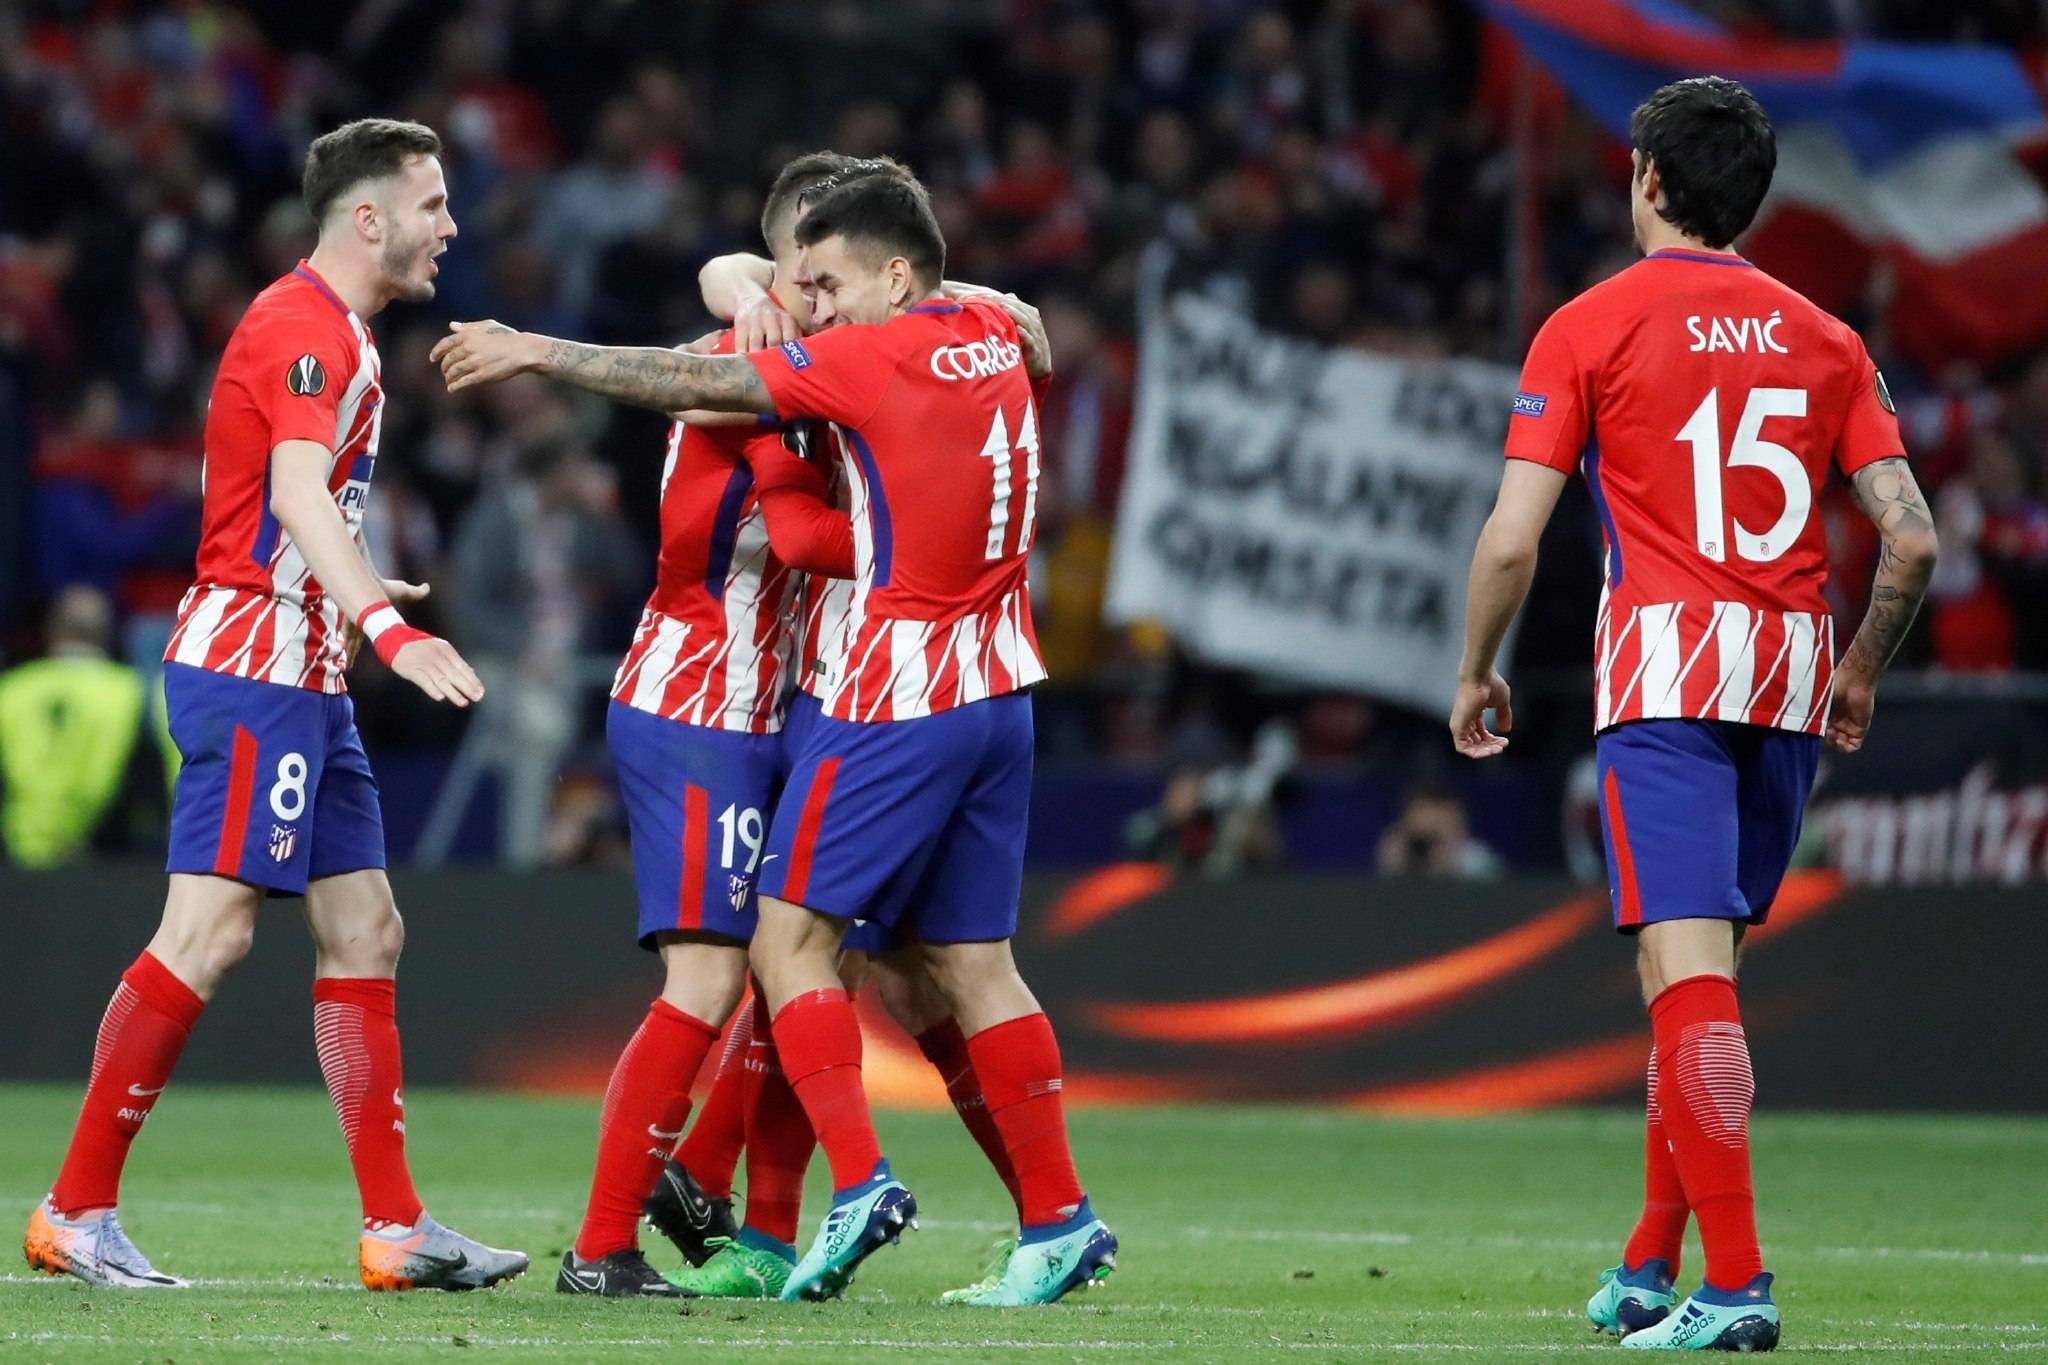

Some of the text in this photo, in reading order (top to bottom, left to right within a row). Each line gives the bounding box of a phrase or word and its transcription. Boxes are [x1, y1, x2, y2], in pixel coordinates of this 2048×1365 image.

[1686, 309, 1789, 354] SAVIĆ
[979, 395, 1040, 561] 11
[1673, 386, 1812, 563] 15
[269, 752, 308, 821] 8
[717, 802, 764, 874] 19
[826, 1205, 861, 1256] adidas
[1668, 1313, 1717, 1347] adidas
